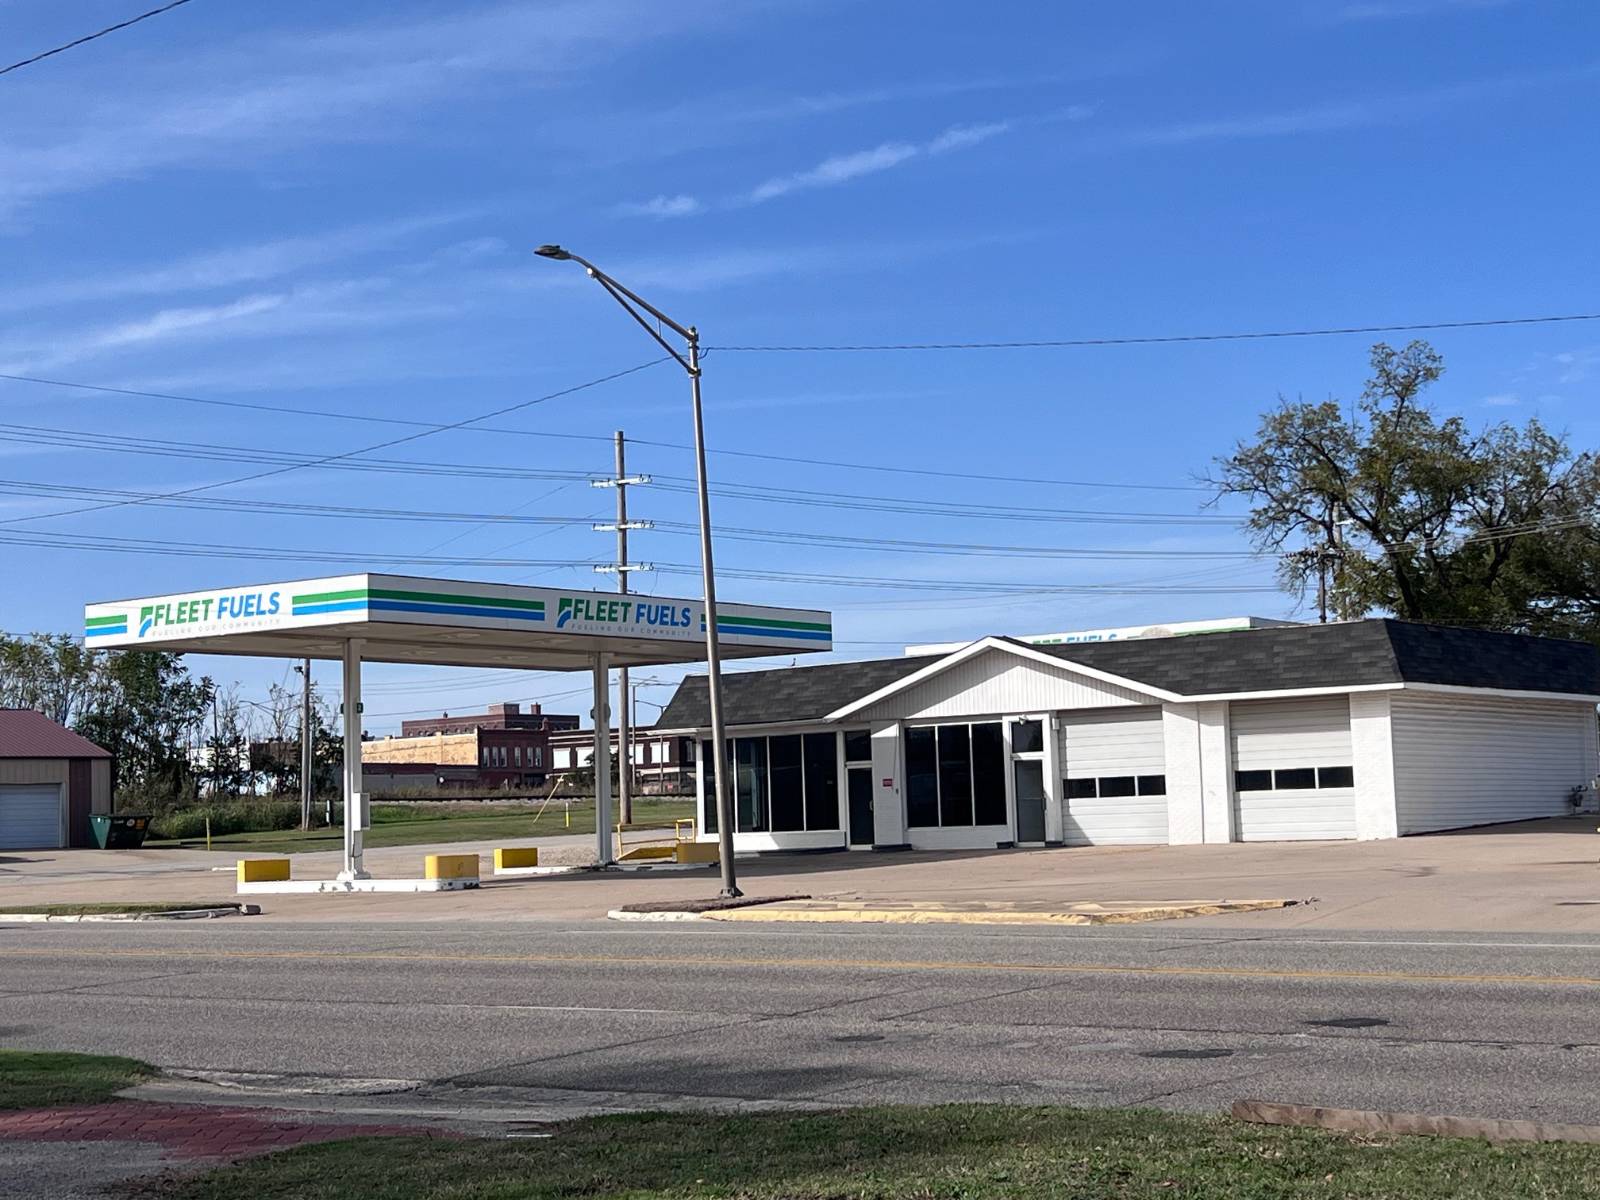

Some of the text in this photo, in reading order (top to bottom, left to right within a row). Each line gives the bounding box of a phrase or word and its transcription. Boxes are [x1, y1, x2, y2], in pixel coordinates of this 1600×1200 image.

[154, 591, 280, 627] FLEET FUELS
[573, 599, 691, 627] FLEET FUELS
